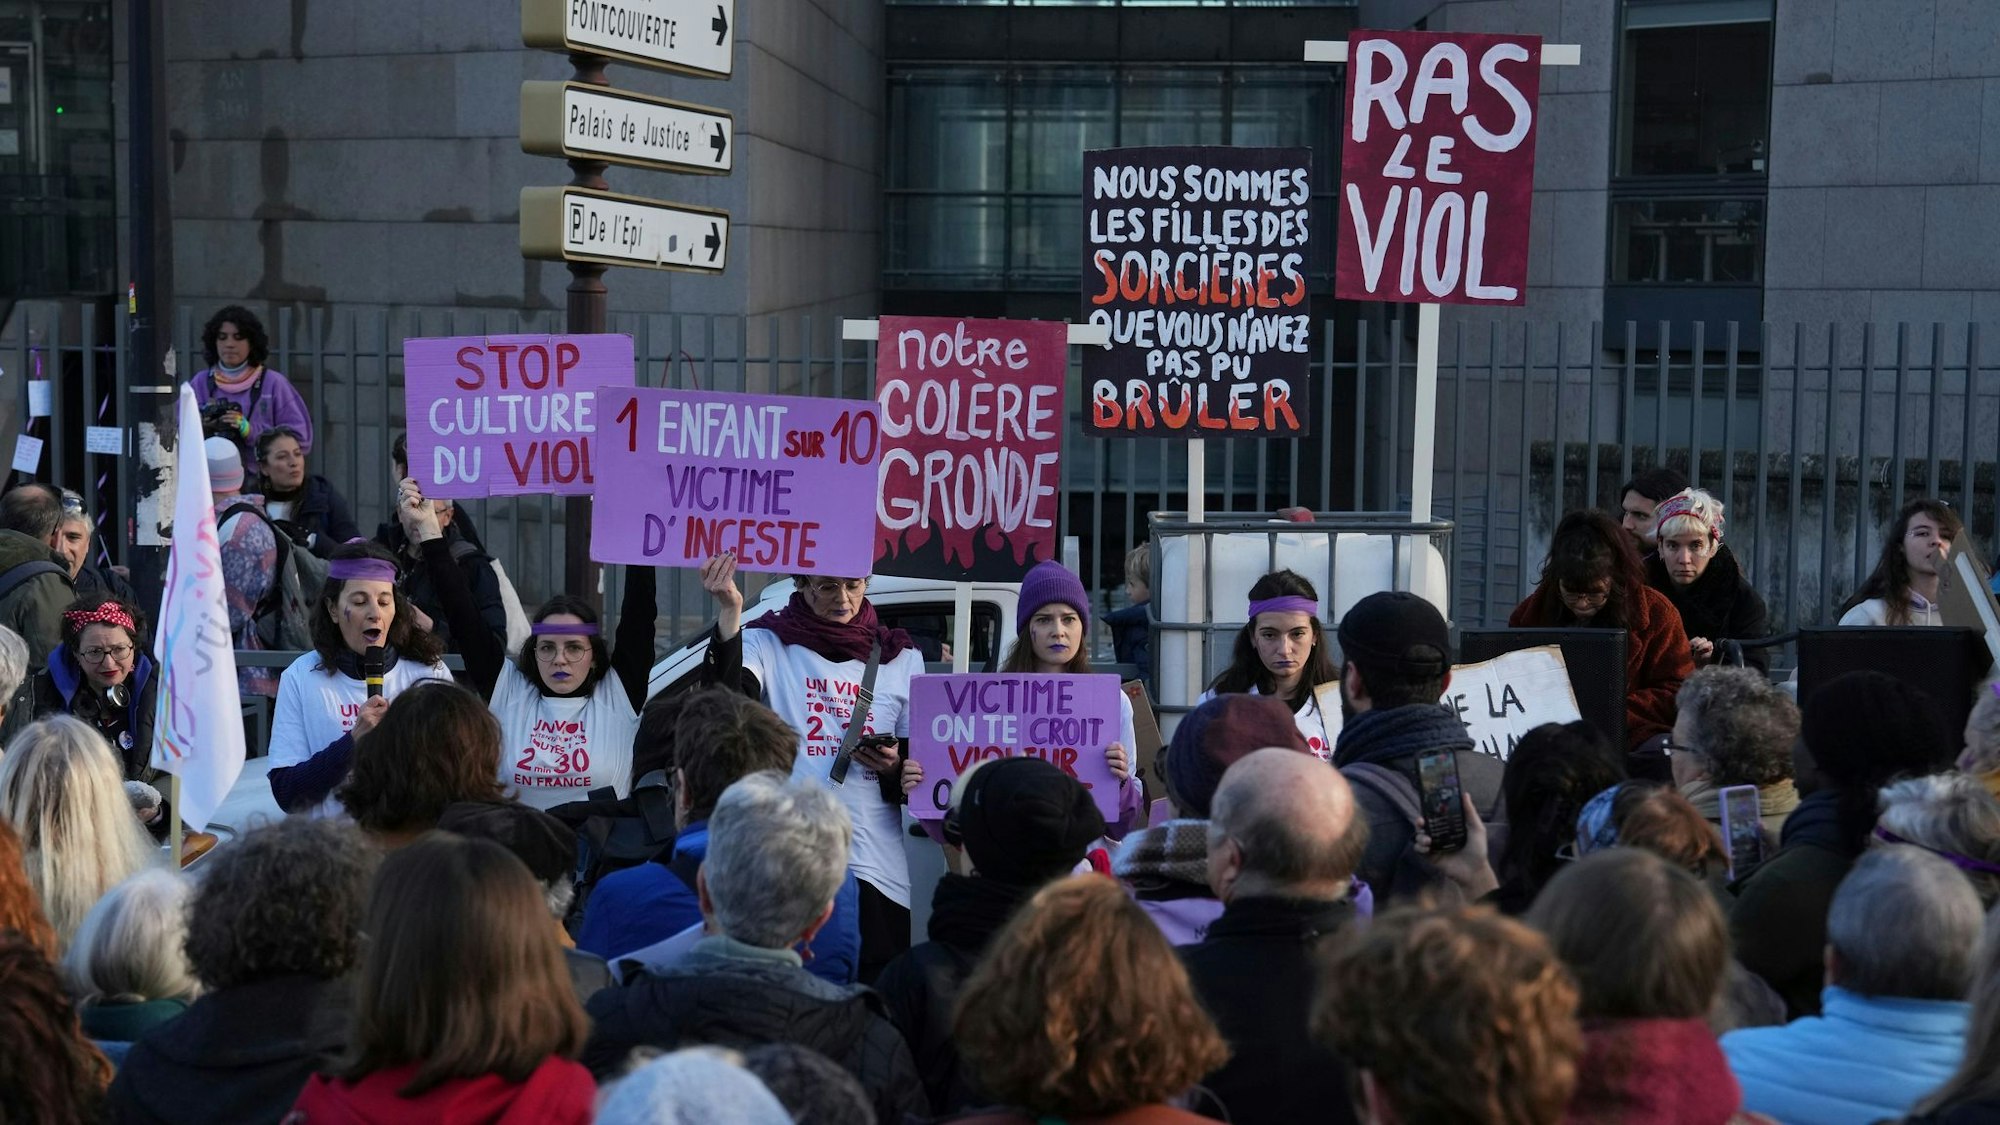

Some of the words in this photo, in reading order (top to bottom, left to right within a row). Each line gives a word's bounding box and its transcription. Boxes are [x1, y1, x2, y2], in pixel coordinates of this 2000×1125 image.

[571, 0, 677, 49] FONTCOUVERTE
[1352, 39, 1532, 152] RAS
[570, 104, 613, 139] Palais
[621, 114, 635, 143] de
[643, 117, 690, 151] Justice
[1383, 134, 1463, 184] LE
[1094, 165, 1179, 200] NOUS
[1183, 165, 1309, 206] SOMMES
[589, 211, 606, 241] De
[613, 215, 643, 253] l'Epi
[1090, 208, 1145, 243] LES
[1152, 201, 1257, 245] FILLES
[1262, 209, 1308, 246] DES
[1346, 183, 1518, 300] VIOL
[1092, 244, 1305, 308] SORCIÈRES
[1089, 309, 1154, 350] QUE
[1157, 311, 1225, 353] VOUS
[1228, 308, 1310, 353] N'AVEZ
[455, 342, 580, 390] STOP
[1146, 350, 1200, 378] PAS
[1211, 354, 1250, 381] PU
[430, 391, 596, 435] CULTURE
[878, 368, 1057, 441] COLÈRE
[1093, 377, 1300, 430] BRÛLER
[616, 397, 638, 452] 1
[658, 400, 788, 460] ENFANT
[831, 410, 878, 465] 10
[433, 445, 481, 484] DU
[504, 437, 594, 486] VIOL
[667, 464, 794, 515] VICTIME
[876, 447, 1058, 533] GRONDE
[806, 677, 828, 693] UN
[834, 681, 860, 697] VIO
[944, 680, 1074, 715] VICTIME
[1485, 683, 1526, 718] LA
[806, 716, 824, 741] 2
[932, 714, 975, 743] ON
[983, 715, 1017, 744] TE
[1030, 718, 1104, 746] CROIT
[516, 747, 536, 771] 2
[535, 766, 552, 774] min
[555, 748, 590, 774] 30
[807, 746, 826, 757] EN
[514, 773, 532, 786] EN
[537, 776, 592, 787] FRANCE
